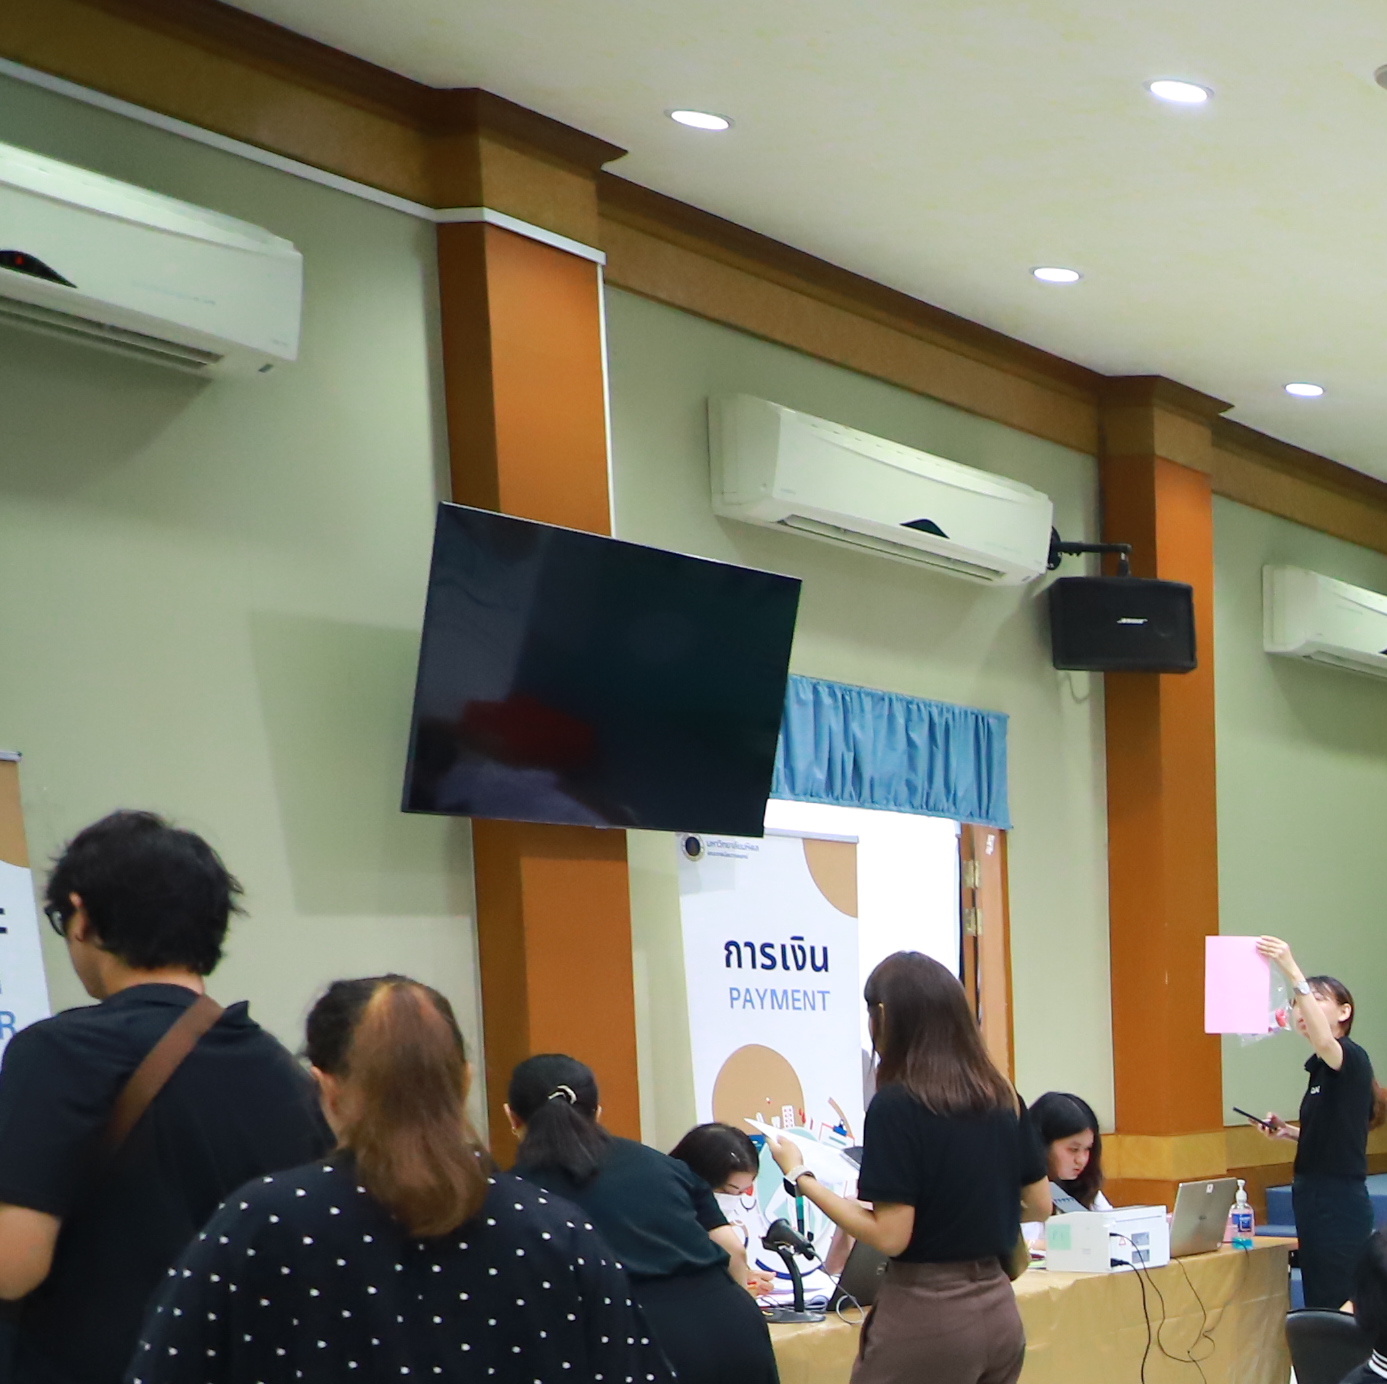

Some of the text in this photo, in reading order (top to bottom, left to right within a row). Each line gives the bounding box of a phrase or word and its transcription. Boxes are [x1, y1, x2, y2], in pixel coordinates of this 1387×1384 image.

[723, 935, 830, 973] การเงิน
[728, 986, 832, 1012] PAYMENT
